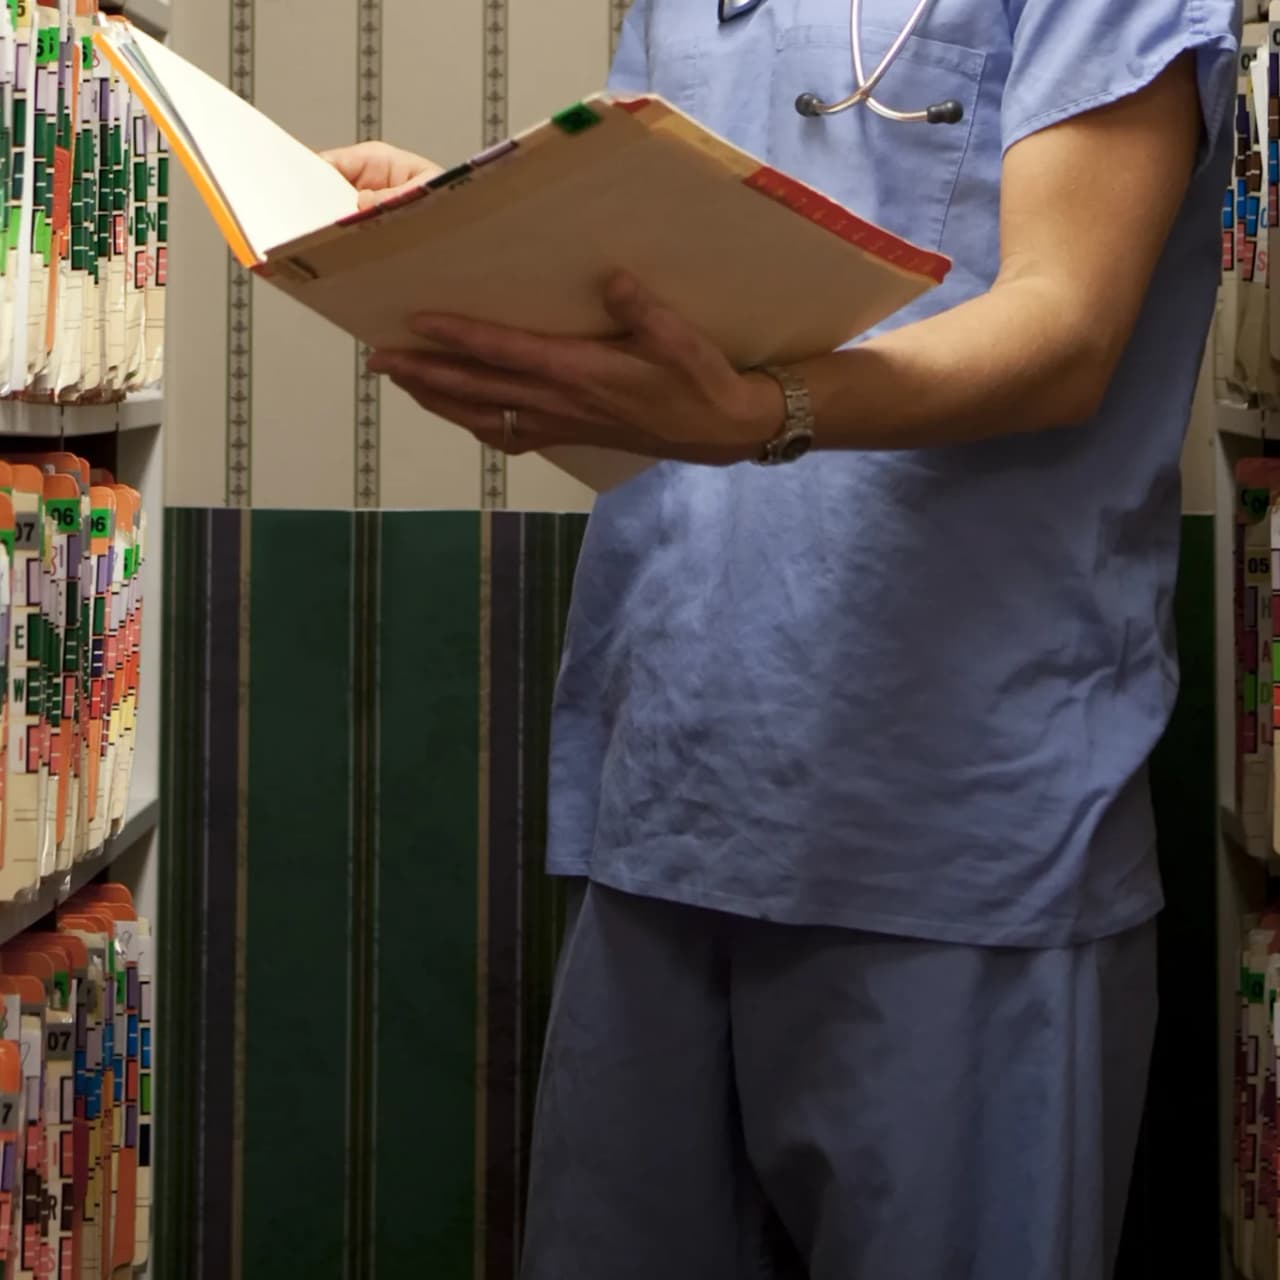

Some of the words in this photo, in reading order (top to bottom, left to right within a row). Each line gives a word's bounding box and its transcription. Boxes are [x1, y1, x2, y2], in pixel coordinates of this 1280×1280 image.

[51, 508, 74, 526] 06
[1248, 557, 1269, 574] 05
[47, 1032, 71, 1051] 07
